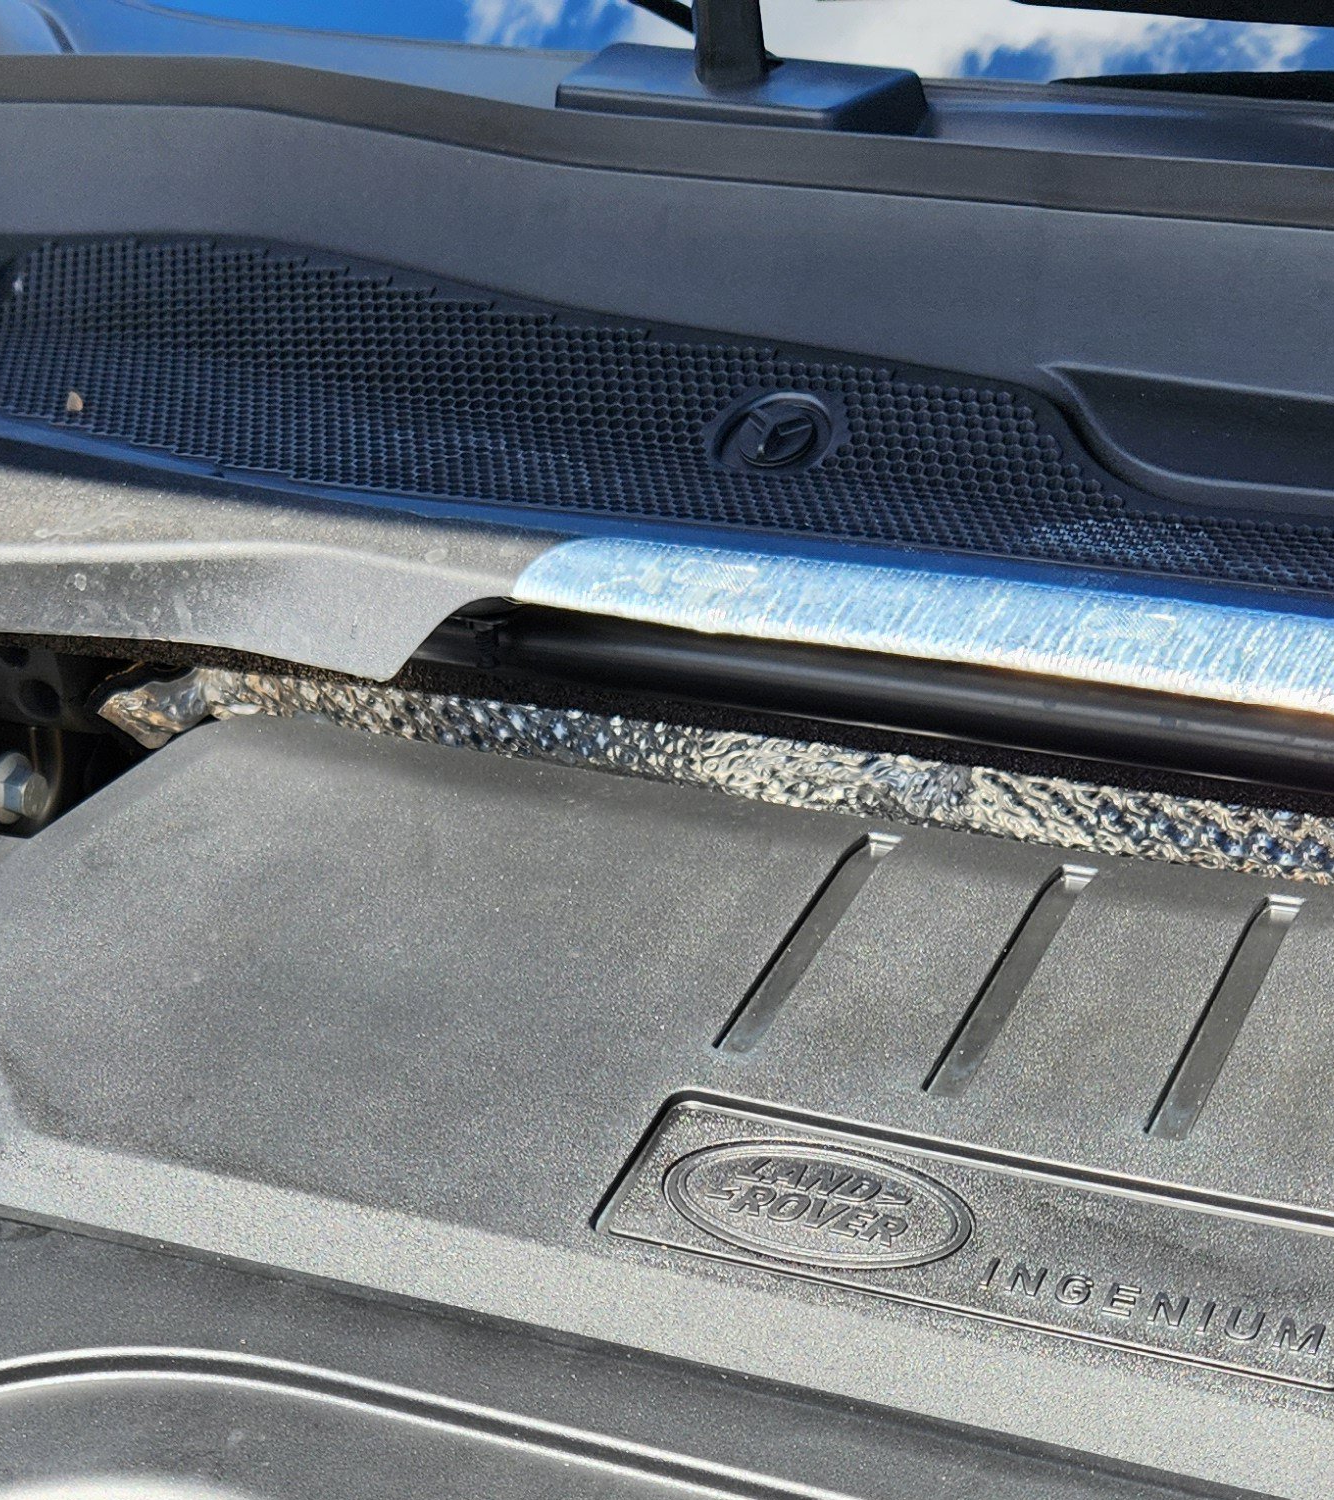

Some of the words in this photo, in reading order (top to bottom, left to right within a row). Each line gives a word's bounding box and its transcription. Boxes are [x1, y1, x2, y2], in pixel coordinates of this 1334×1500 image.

[733, 1157, 885, 1206] LAND
[727, 1186, 910, 1248] ROVER
[977, 1255, 1328, 1356] INGENIUM
